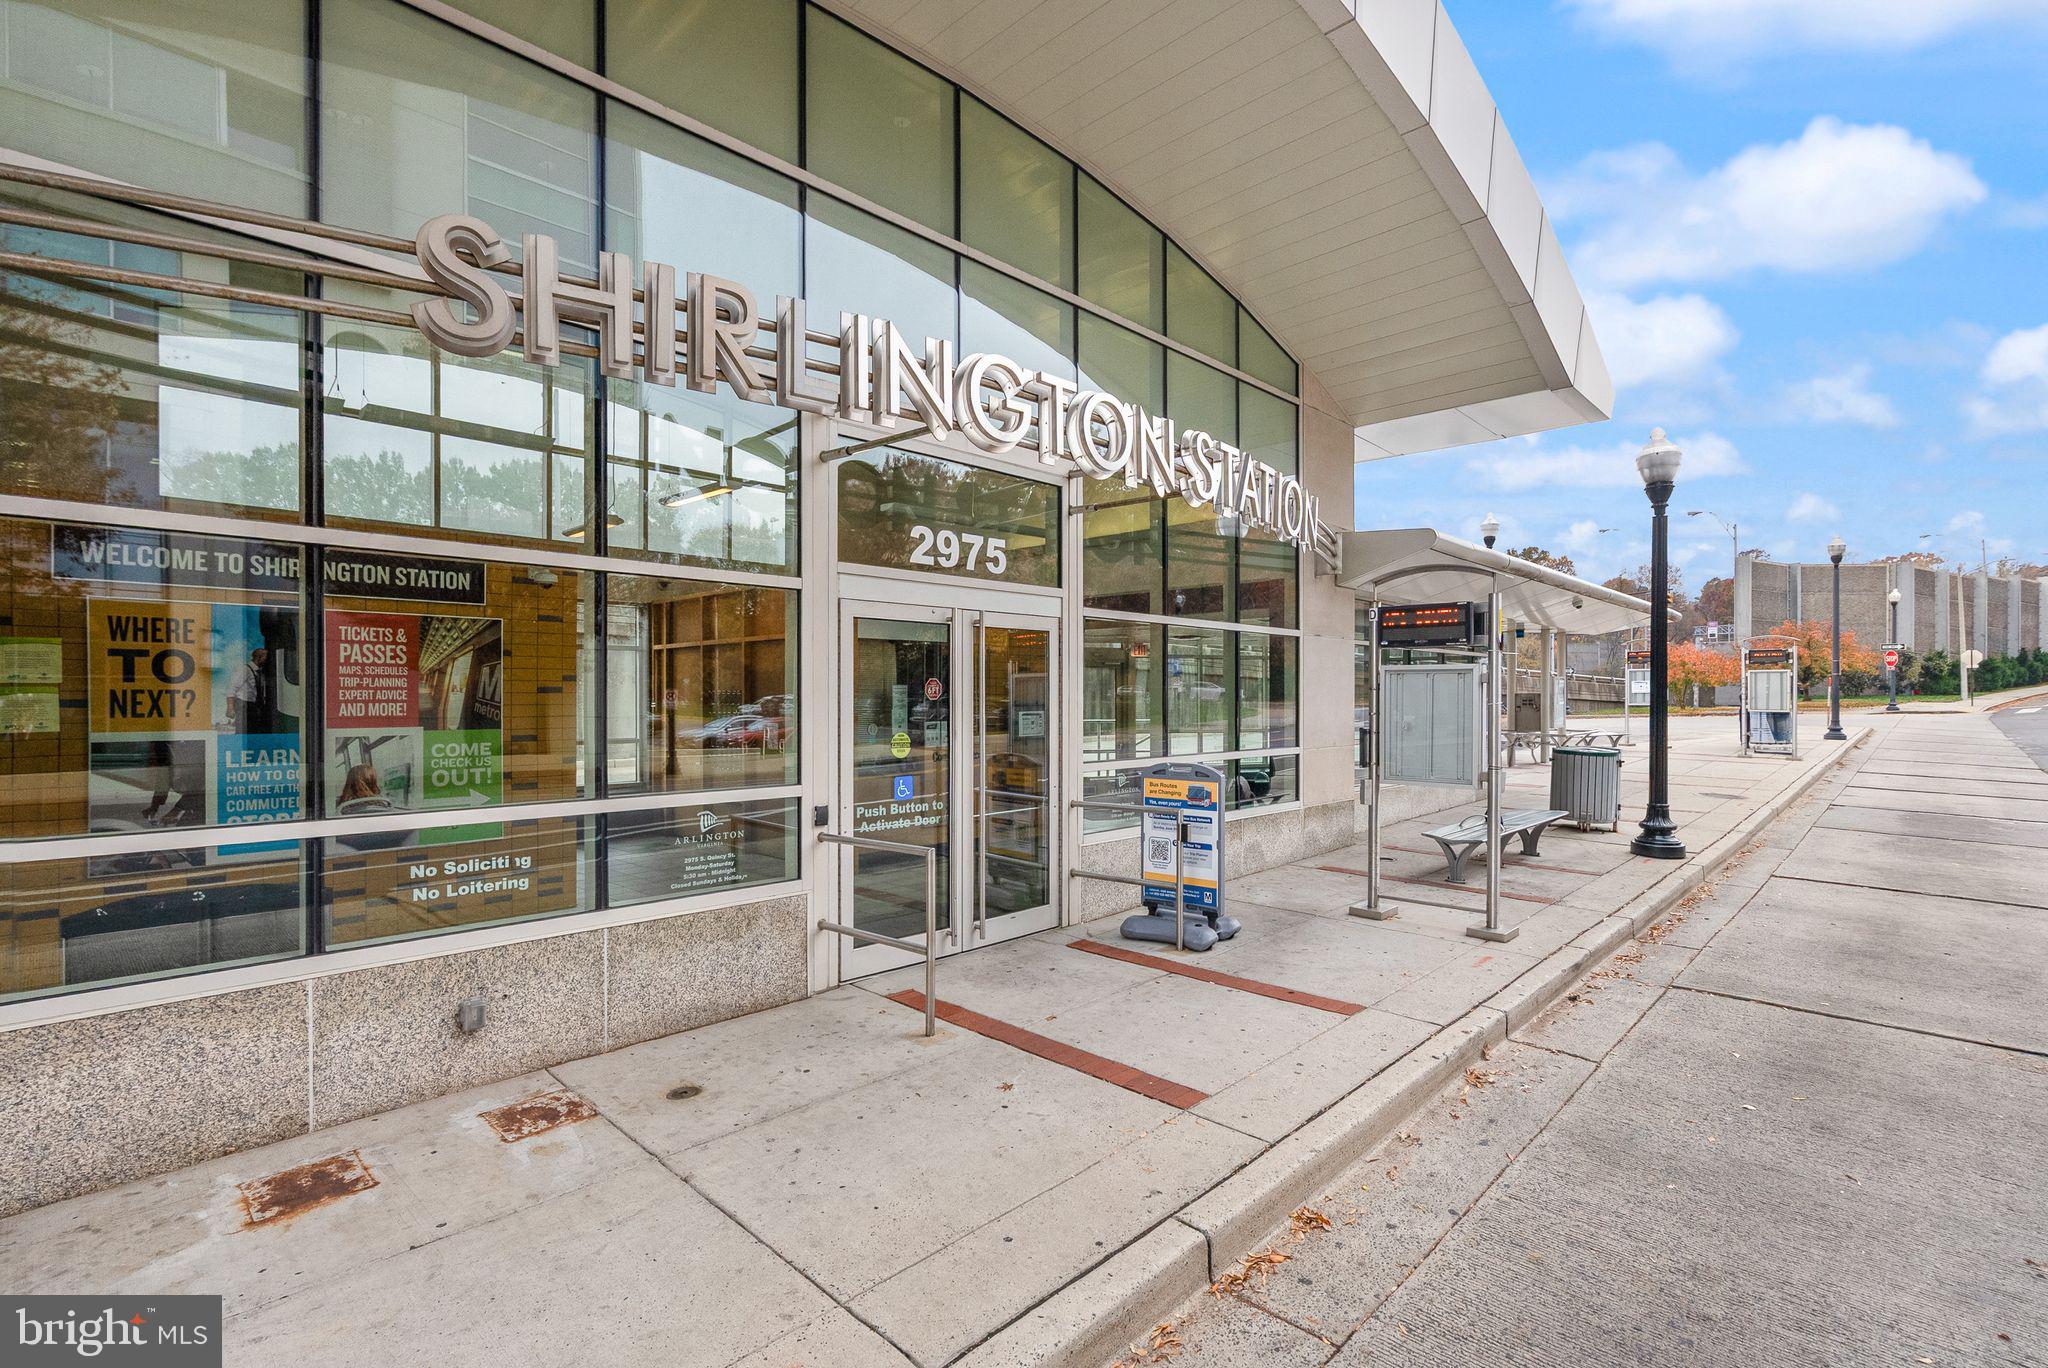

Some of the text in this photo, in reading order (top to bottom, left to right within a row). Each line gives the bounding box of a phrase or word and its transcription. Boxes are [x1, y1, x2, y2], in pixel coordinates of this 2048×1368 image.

[409, 213, 1320, 552] SHIRLINGTON STATION
[910, 525, 1007, 575] 2975
[80, 540, 471, 591] WELCOME TO SHIRNGTON STATION
[107, 615, 195, 644] WHERE
[339, 625, 407, 642] TICKETS &
[339, 643, 407, 664] PASSES
[107, 648, 196, 684] TO
[339, 665, 408, 676] MAPS, SCHEDULES
[339, 677, 408, 689] TRIP-PLANNING
[339, 689, 407, 700] EXPERT ADVICE
[109, 688, 197, 719] NEXT?
[339, 702, 407, 717] AND MORE!
[473, 702, 500, 720] metro
[431, 742, 492, 758] COME
[430, 757, 492, 769] CHECK US
[227, 771, 260, 783] HOW
[264, 770, 282, 781] TO
[431, 766, 492, 787] OUT!
[226, 784, 299, 797] CAR FREE AT TH
[856, 800, 944, 818] Push Button to
[860, 814, 941, 833] Activate Door
[674, 830, 745, 845] ARLINGTON
[409, 865, 437, 879] No
[412, 877, 529, 902] No Loitering
[670, 881, 691, 889] Closed
